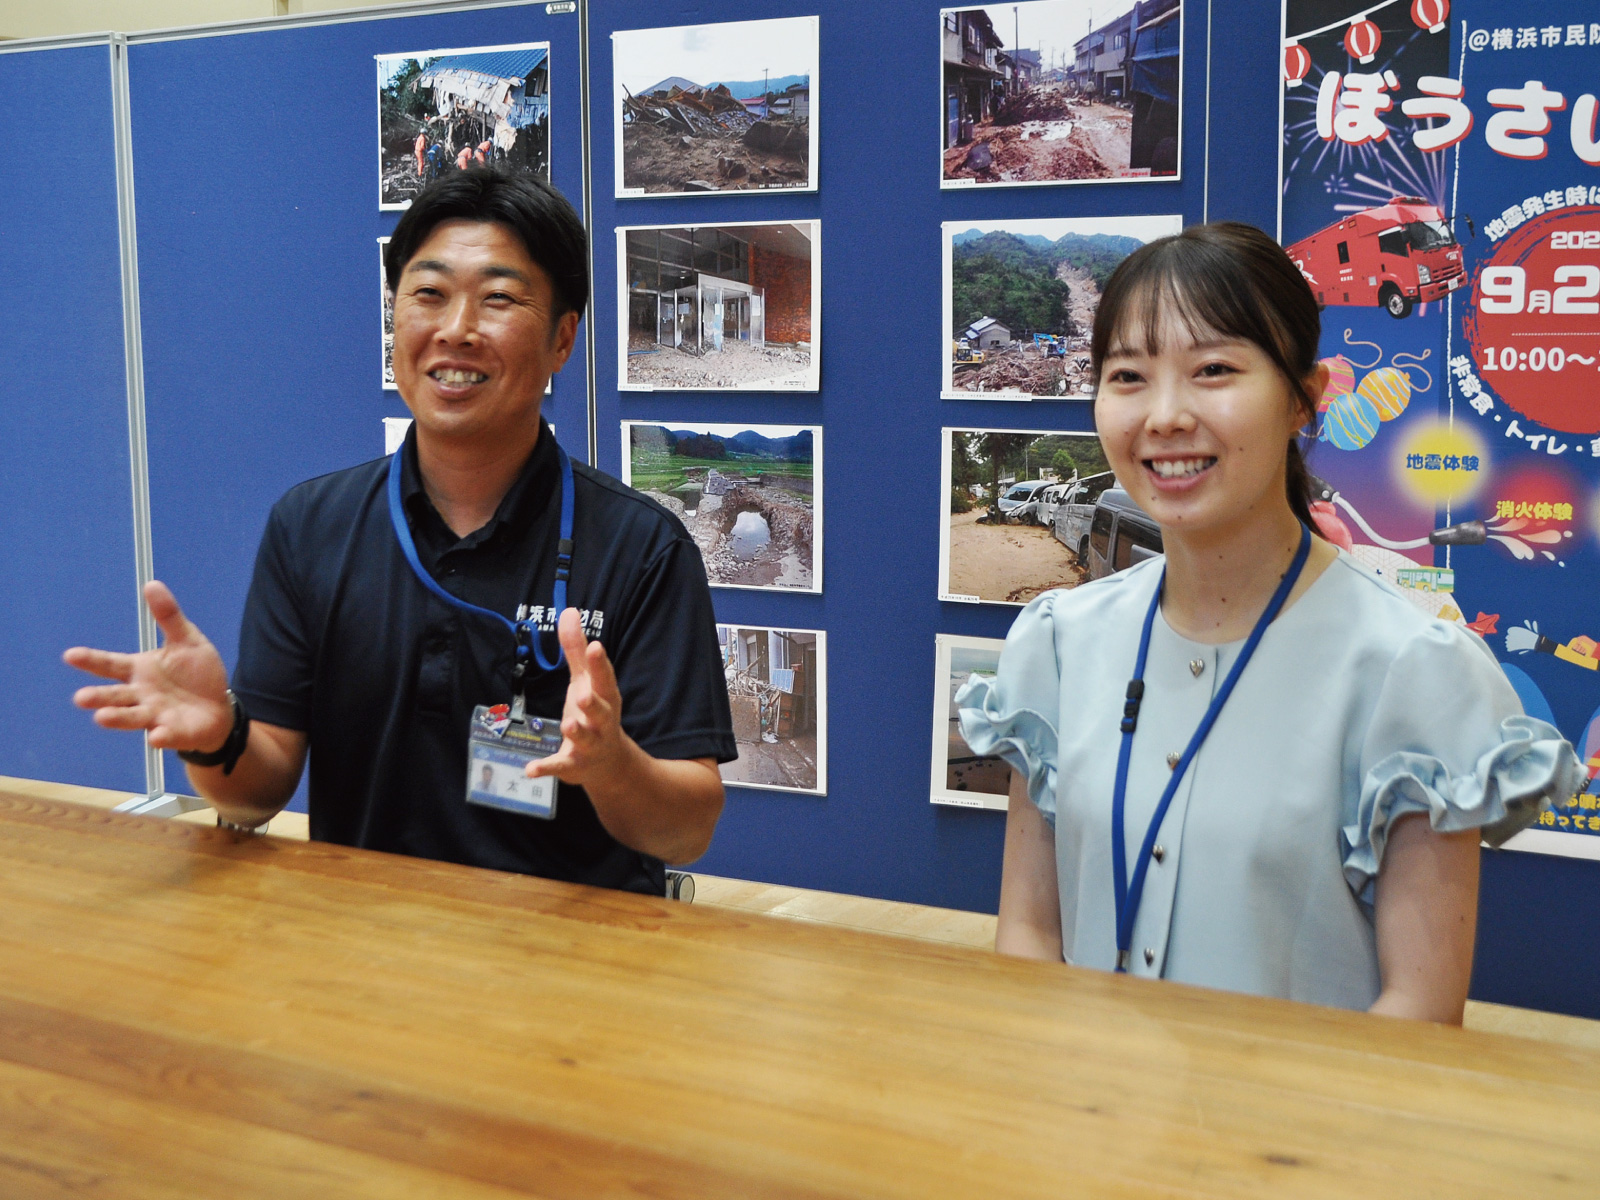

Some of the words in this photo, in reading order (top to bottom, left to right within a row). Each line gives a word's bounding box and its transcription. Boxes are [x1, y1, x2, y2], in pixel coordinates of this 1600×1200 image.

[1406, 453, 1480, 472] 地震体験
[1496, 500, 1573, 521] 消火体験
[516, 603, 605, 630] 浜市局
